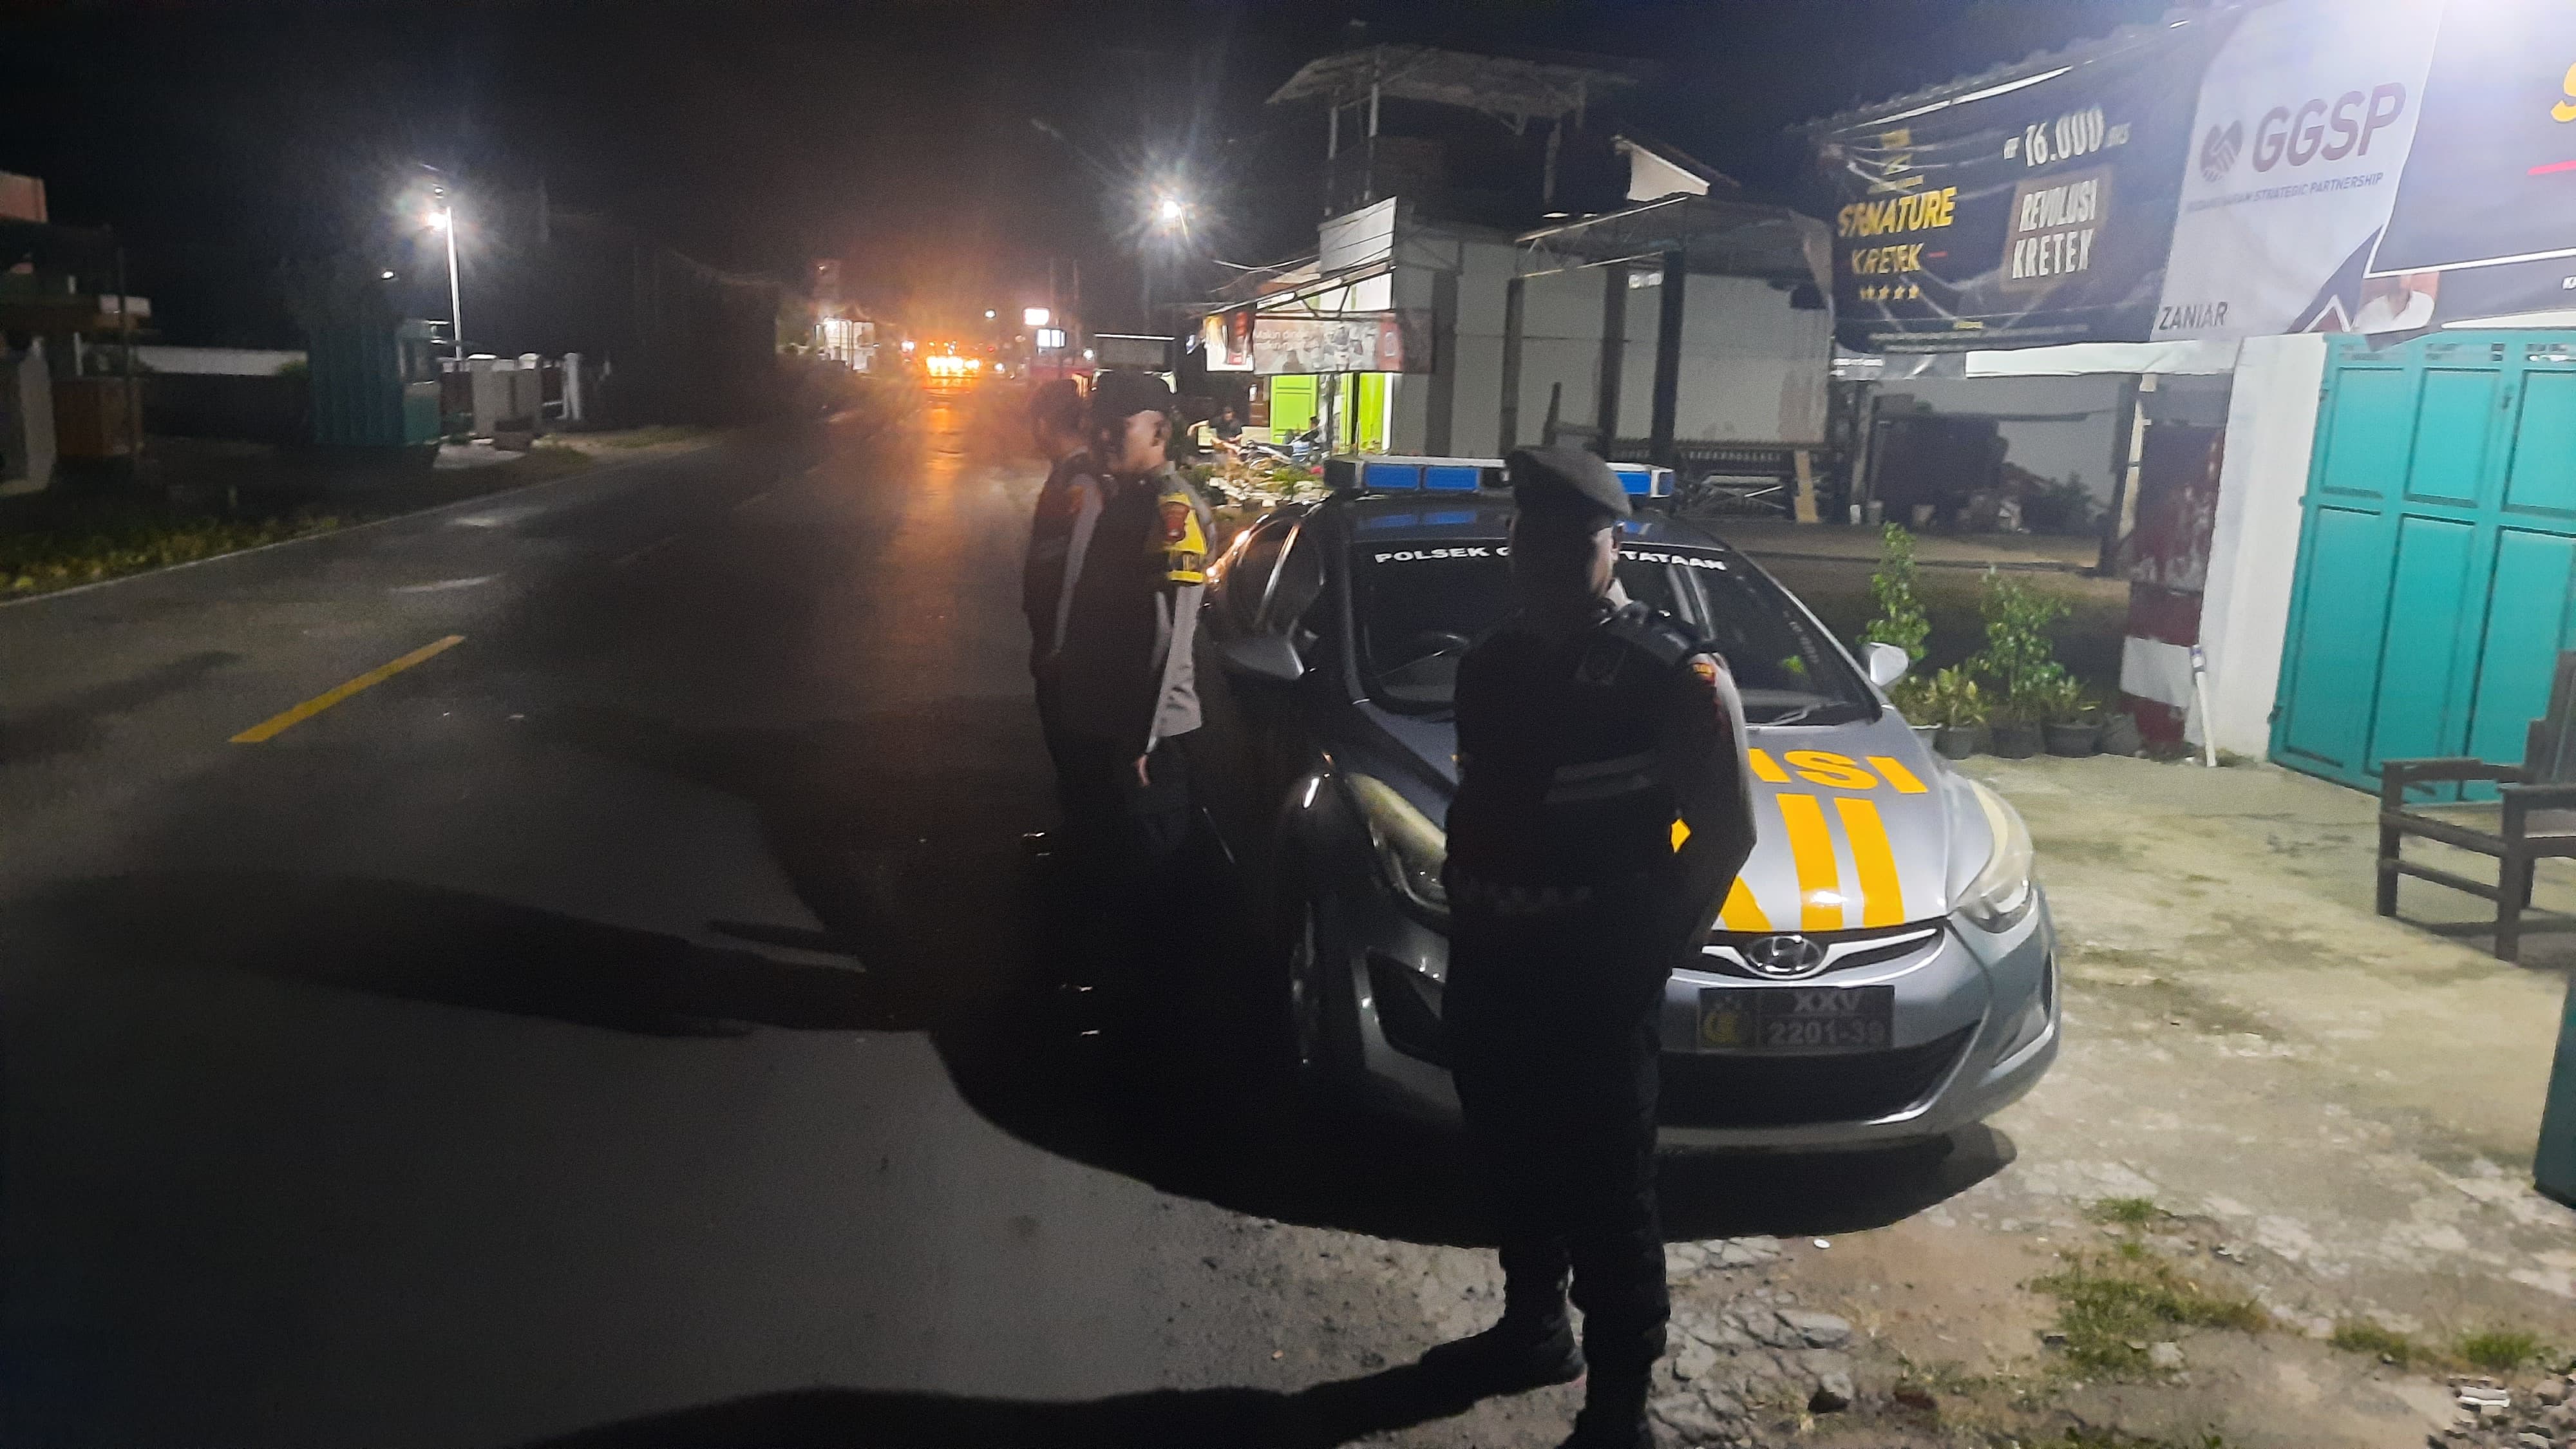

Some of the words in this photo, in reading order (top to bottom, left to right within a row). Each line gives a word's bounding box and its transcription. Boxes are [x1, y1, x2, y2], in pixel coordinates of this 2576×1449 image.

[2025, 107, 2104, 167] 16.000
[2252, 82, 2406, 173] GGSP
[2253, 184, 2308, 202] STRATEGIC
[2309, 172, 2384, 194] PARTNERSHIP
[1851, 242, 1925, 274] KRETEK
[2012, 228, 2094, 279] KRETEK
[1374, 547, 1491, 563] POLSEK
[1618, 551, 1727, 571] TATAAN
[1748, 748, 1928, 794] ISI
[1793, 990, 1864, 1012] XXV
